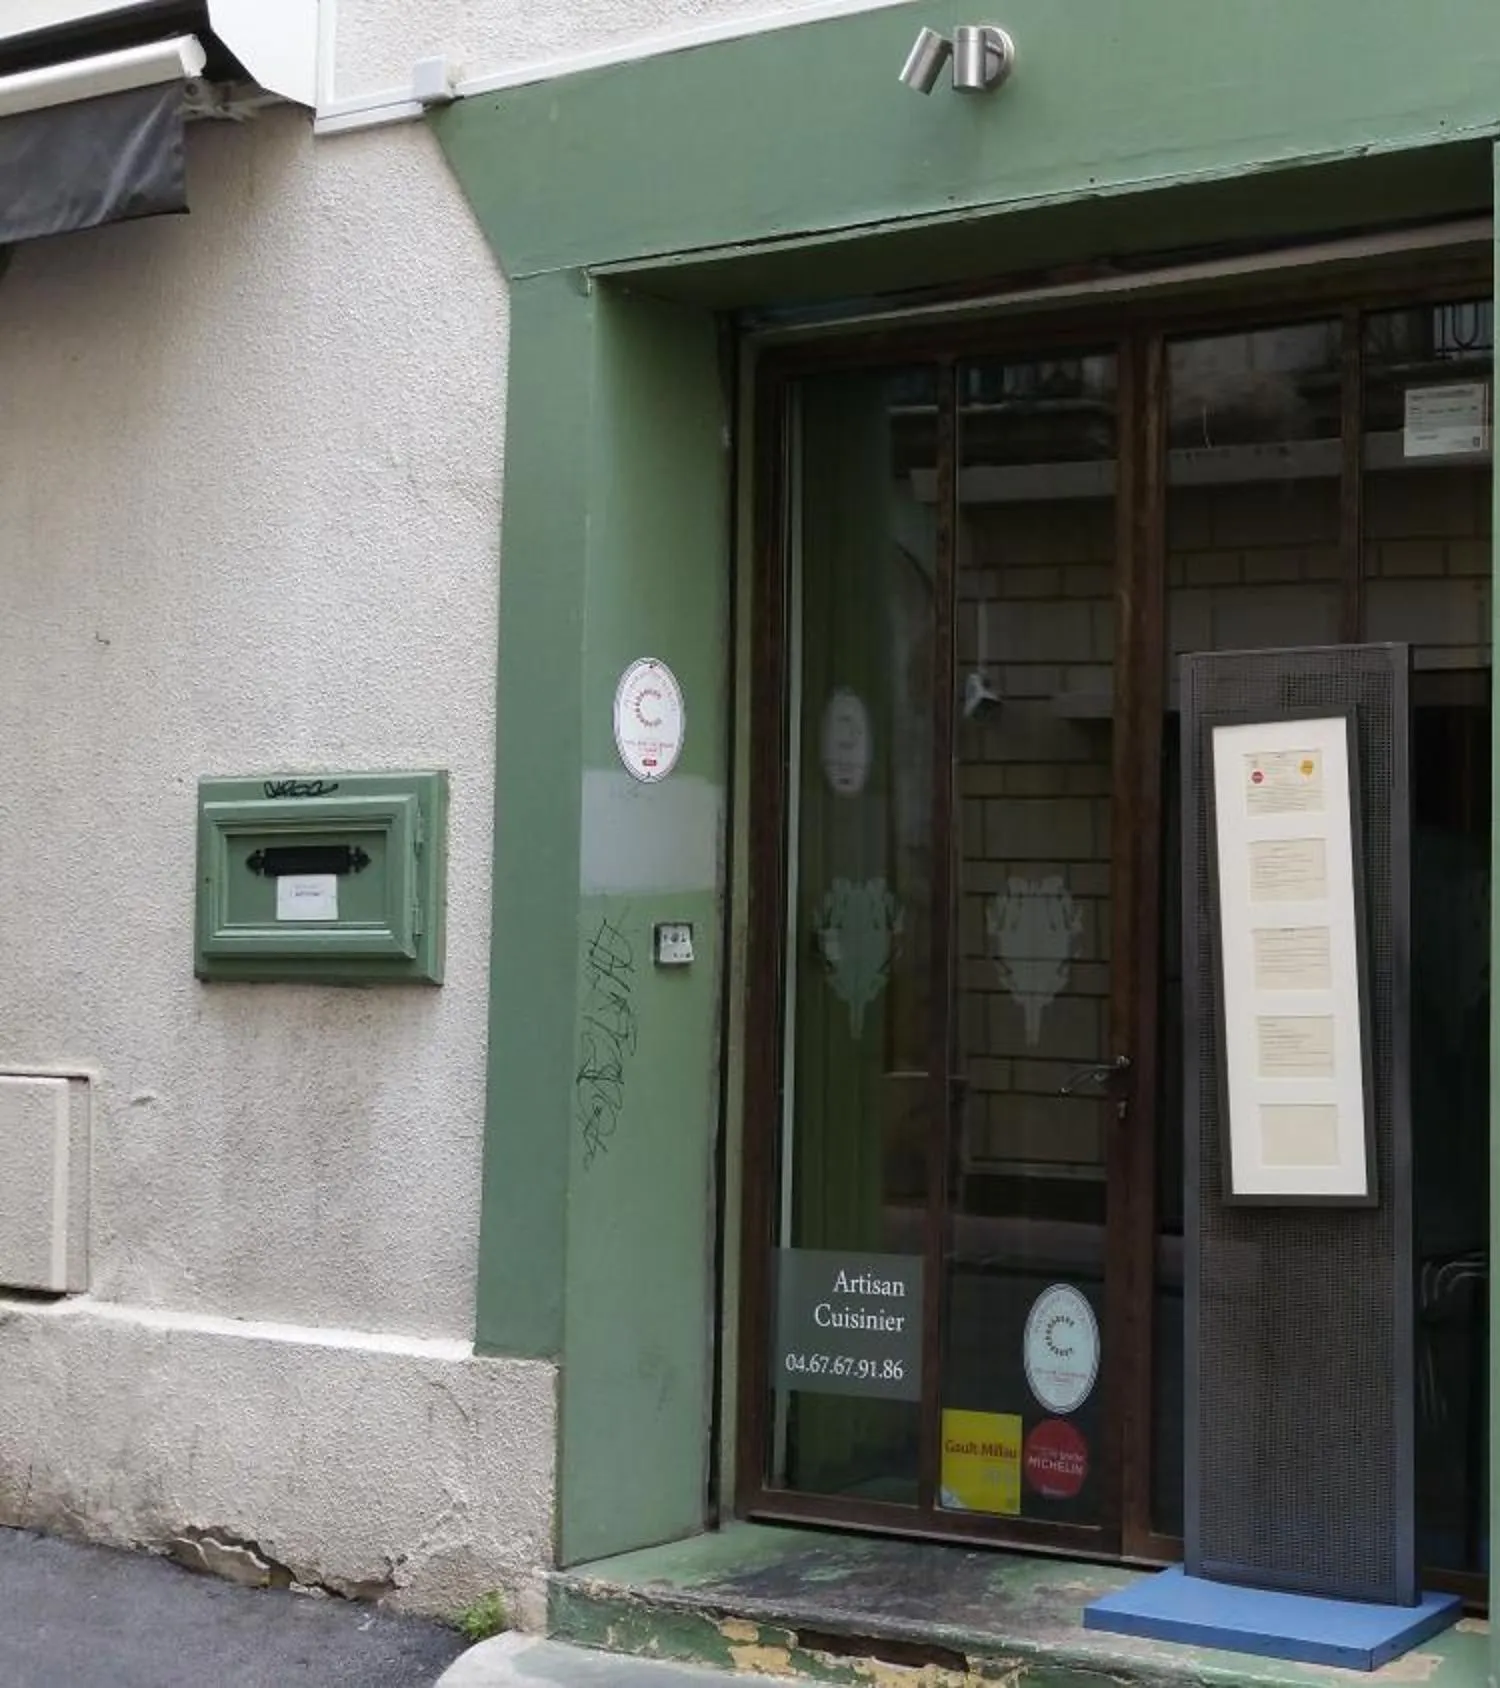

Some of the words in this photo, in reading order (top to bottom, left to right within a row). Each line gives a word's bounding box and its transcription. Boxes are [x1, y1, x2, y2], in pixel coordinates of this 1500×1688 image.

[833, 1269, 905, 1297] Artisan
[814, 1303, 905, 1332] Cuisinier
[785, 1352, 904, 1380] 04.67.67.91.86
[1028, 1456, 1083, 1476] MICHELIN
